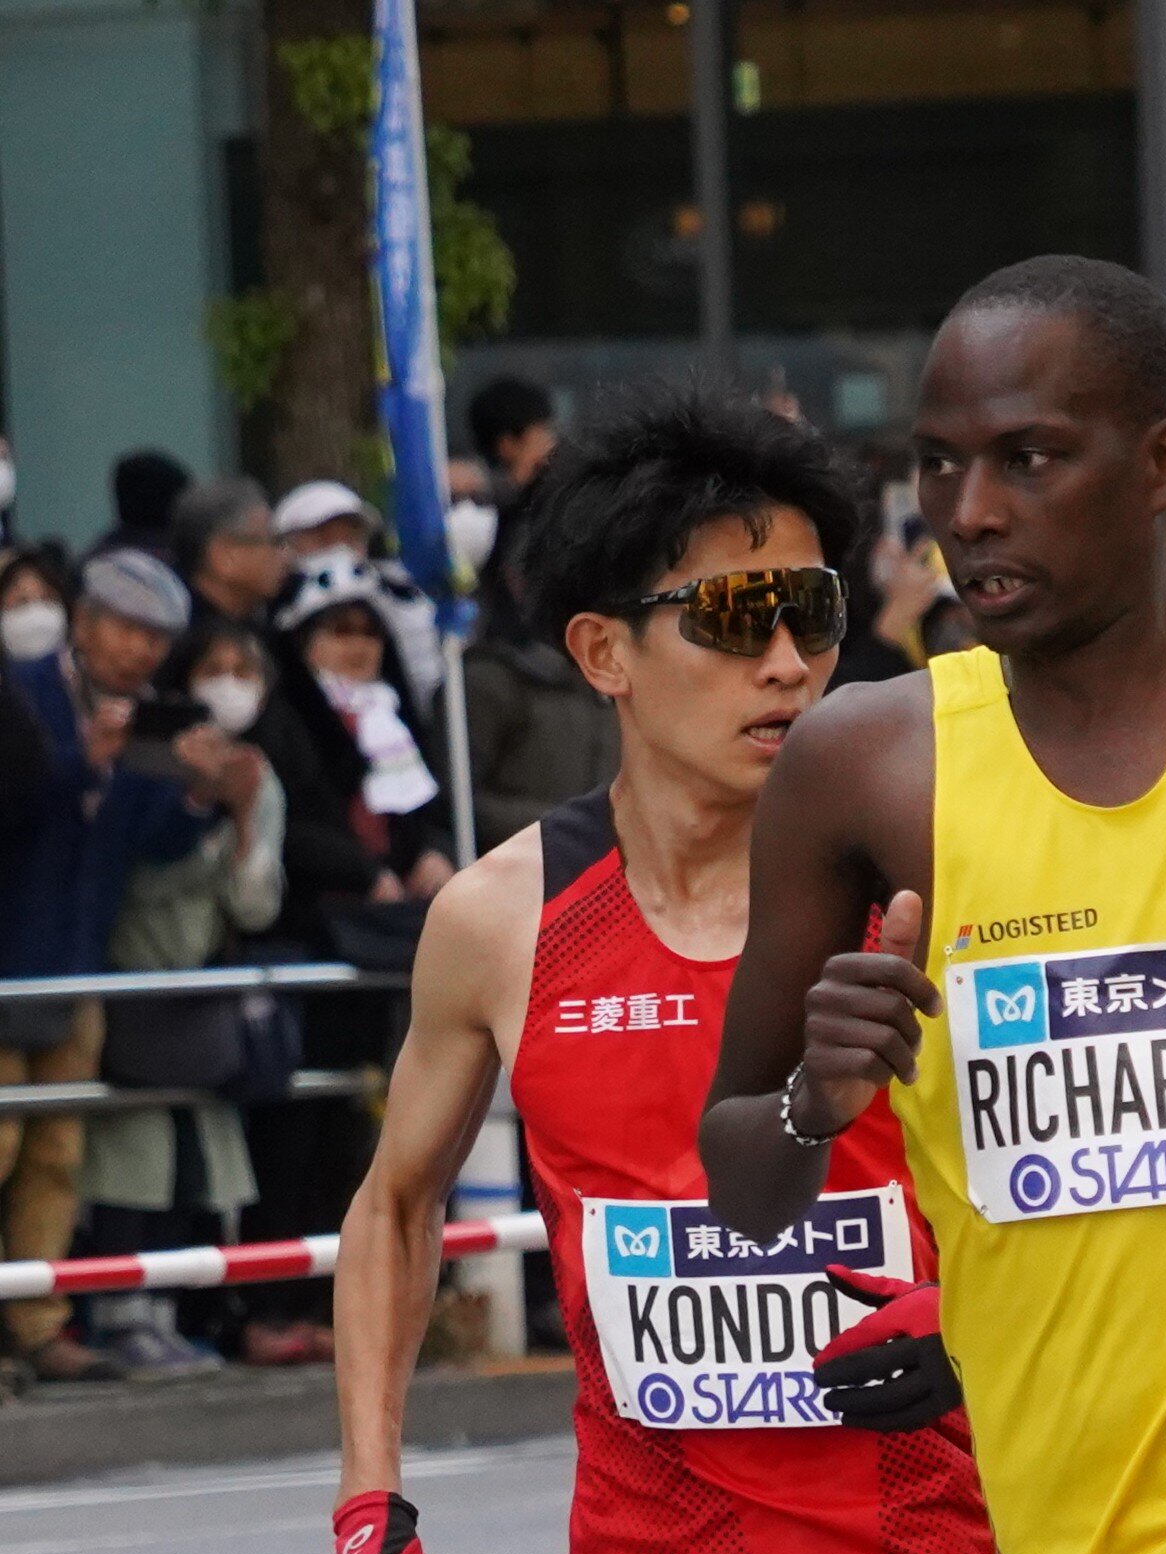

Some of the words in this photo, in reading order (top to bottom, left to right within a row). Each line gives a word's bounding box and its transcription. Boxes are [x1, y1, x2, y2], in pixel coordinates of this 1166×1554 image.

[977, 907, 1098, 944] LOGISTEED
[554, 992, 699, 1034] 三菱重工
[627, 1280, 840, 1365] KONDO
